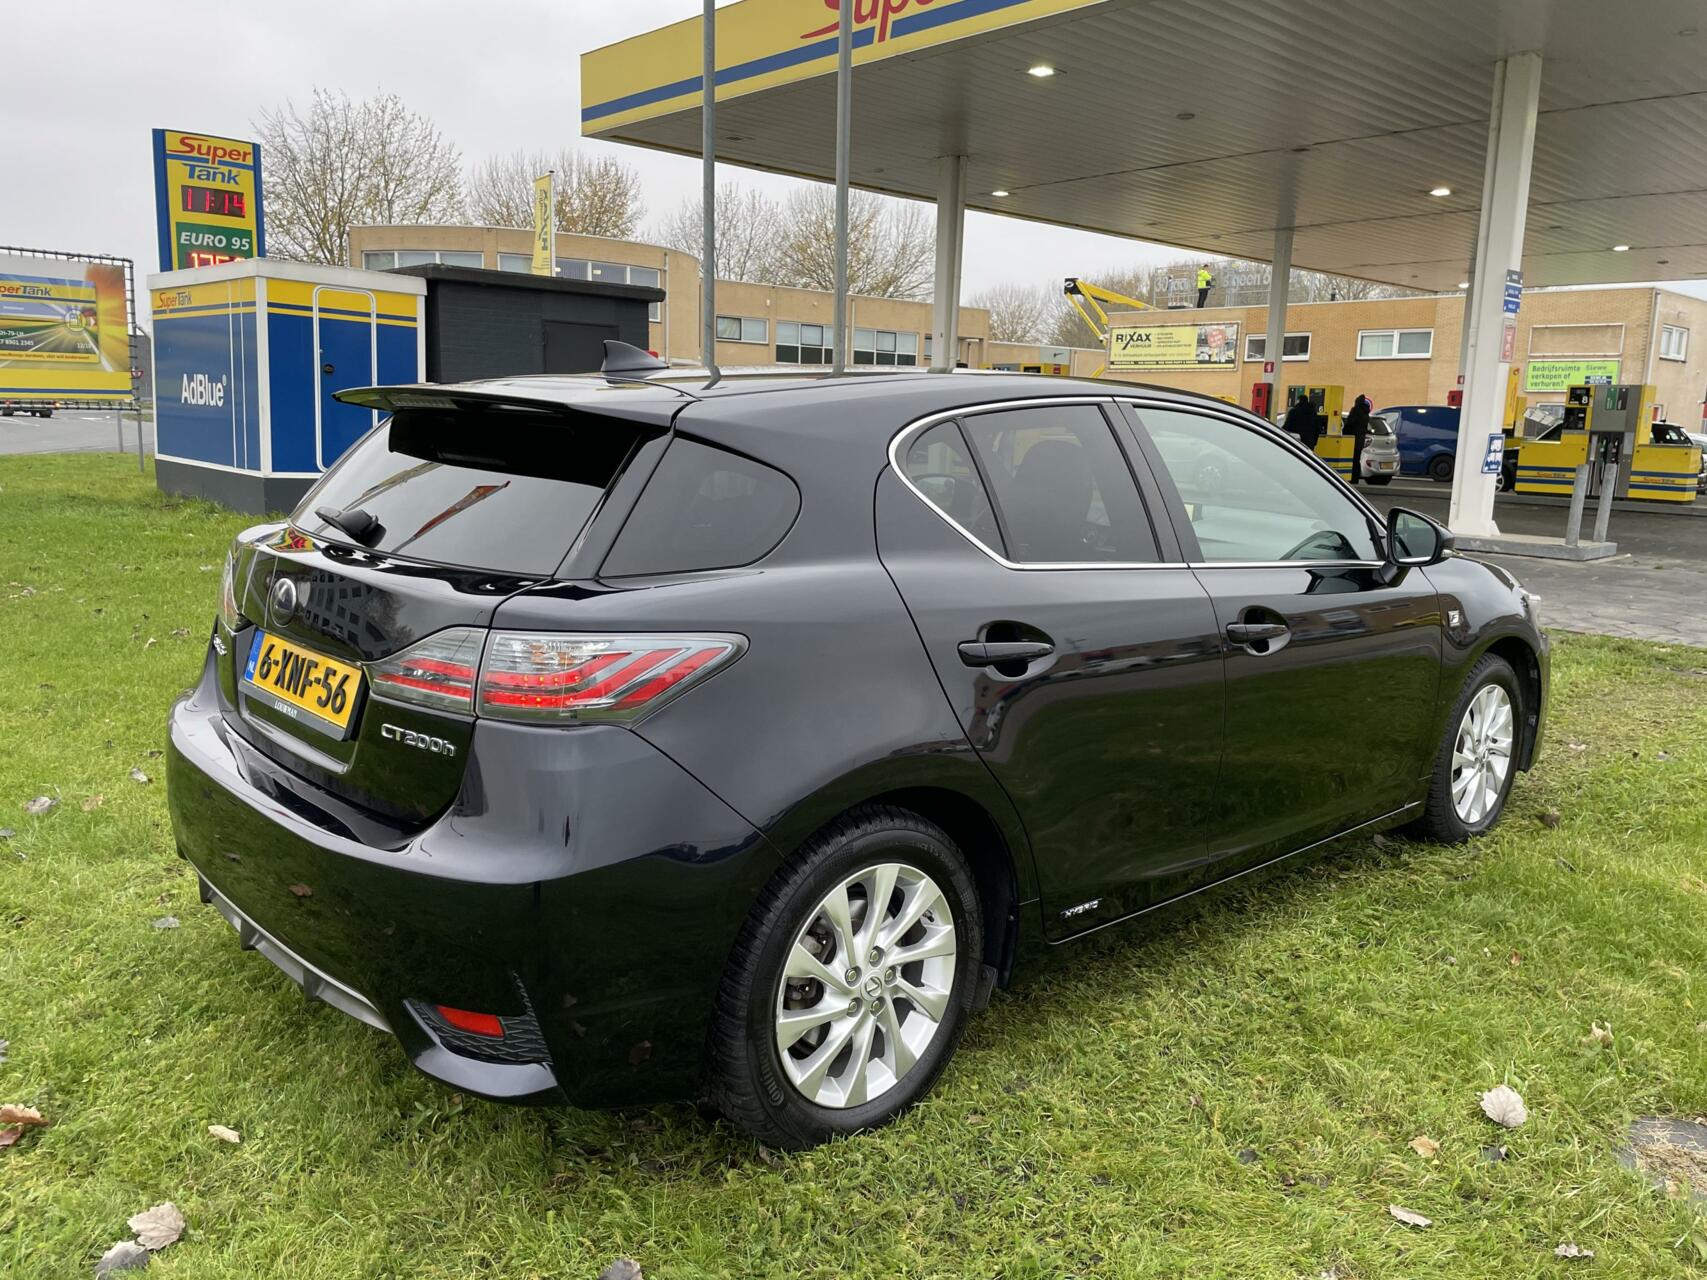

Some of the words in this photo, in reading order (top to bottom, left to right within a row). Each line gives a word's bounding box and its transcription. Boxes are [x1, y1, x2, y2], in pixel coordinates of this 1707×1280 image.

[166, 136, 252, 165] Super
[181, 163, 241, 185] Tank
[187, 188, 246, 216] 11:14
[180, 231, 227, 248] EURO
[231, 237, 251, 250] 95
[1115, 331, 1152, 351] RIXAX
[1532, 365, 1581, 373] Bedrijfsruimte
[181, 373, 224, 408] AdBlue
[258, 643, 351, 715] 6-XNF-56
